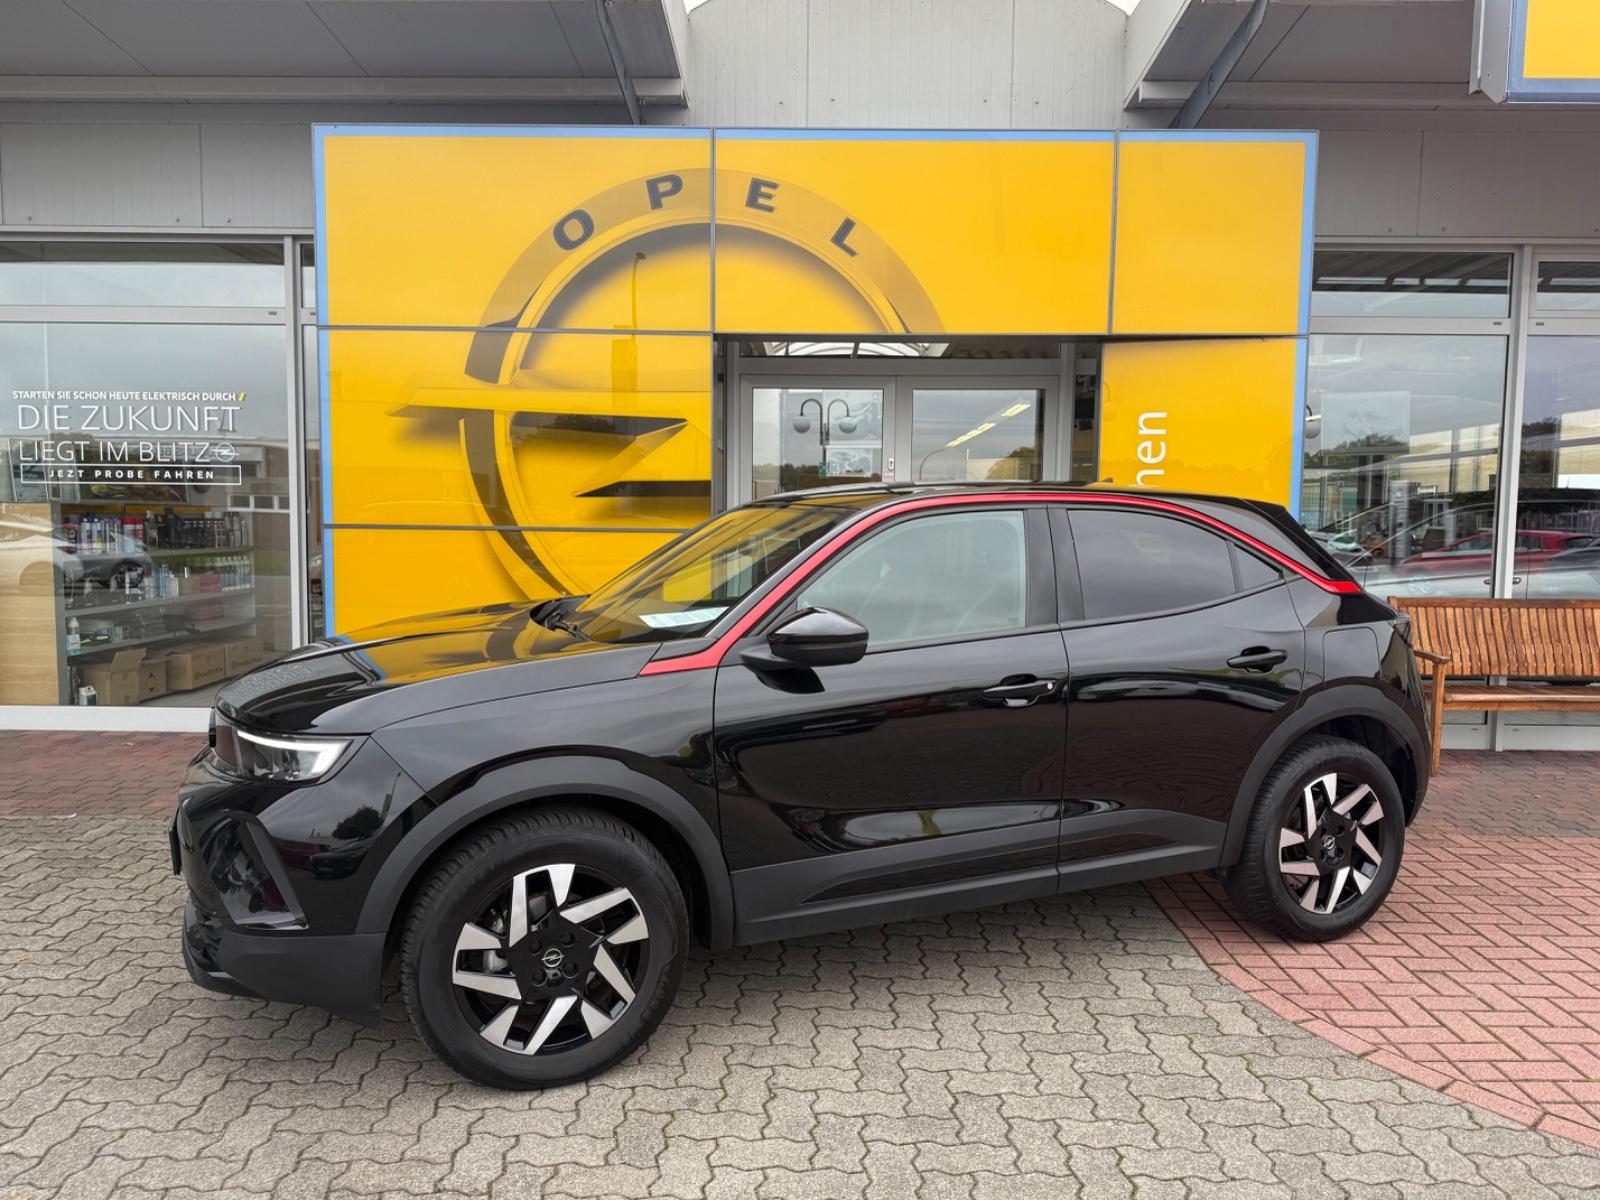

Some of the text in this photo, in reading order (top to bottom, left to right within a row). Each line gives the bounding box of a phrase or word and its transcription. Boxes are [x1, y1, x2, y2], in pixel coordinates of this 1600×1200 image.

[553, 174, 859, 257] OPEL
[12, 390, 236, 401] STARTEN SIE SCHON HEUTE ELEKTRISCH DURCH
[18, 404, 241, 431] DIE ZUKUNFT
[20, 441, 90, 461] LIEGT
[100, 441, 129, 462] IM
[139, 441, 211, 462] BLITZ
[49, 469, 214, 479] JEZT PROBE FAHREN
